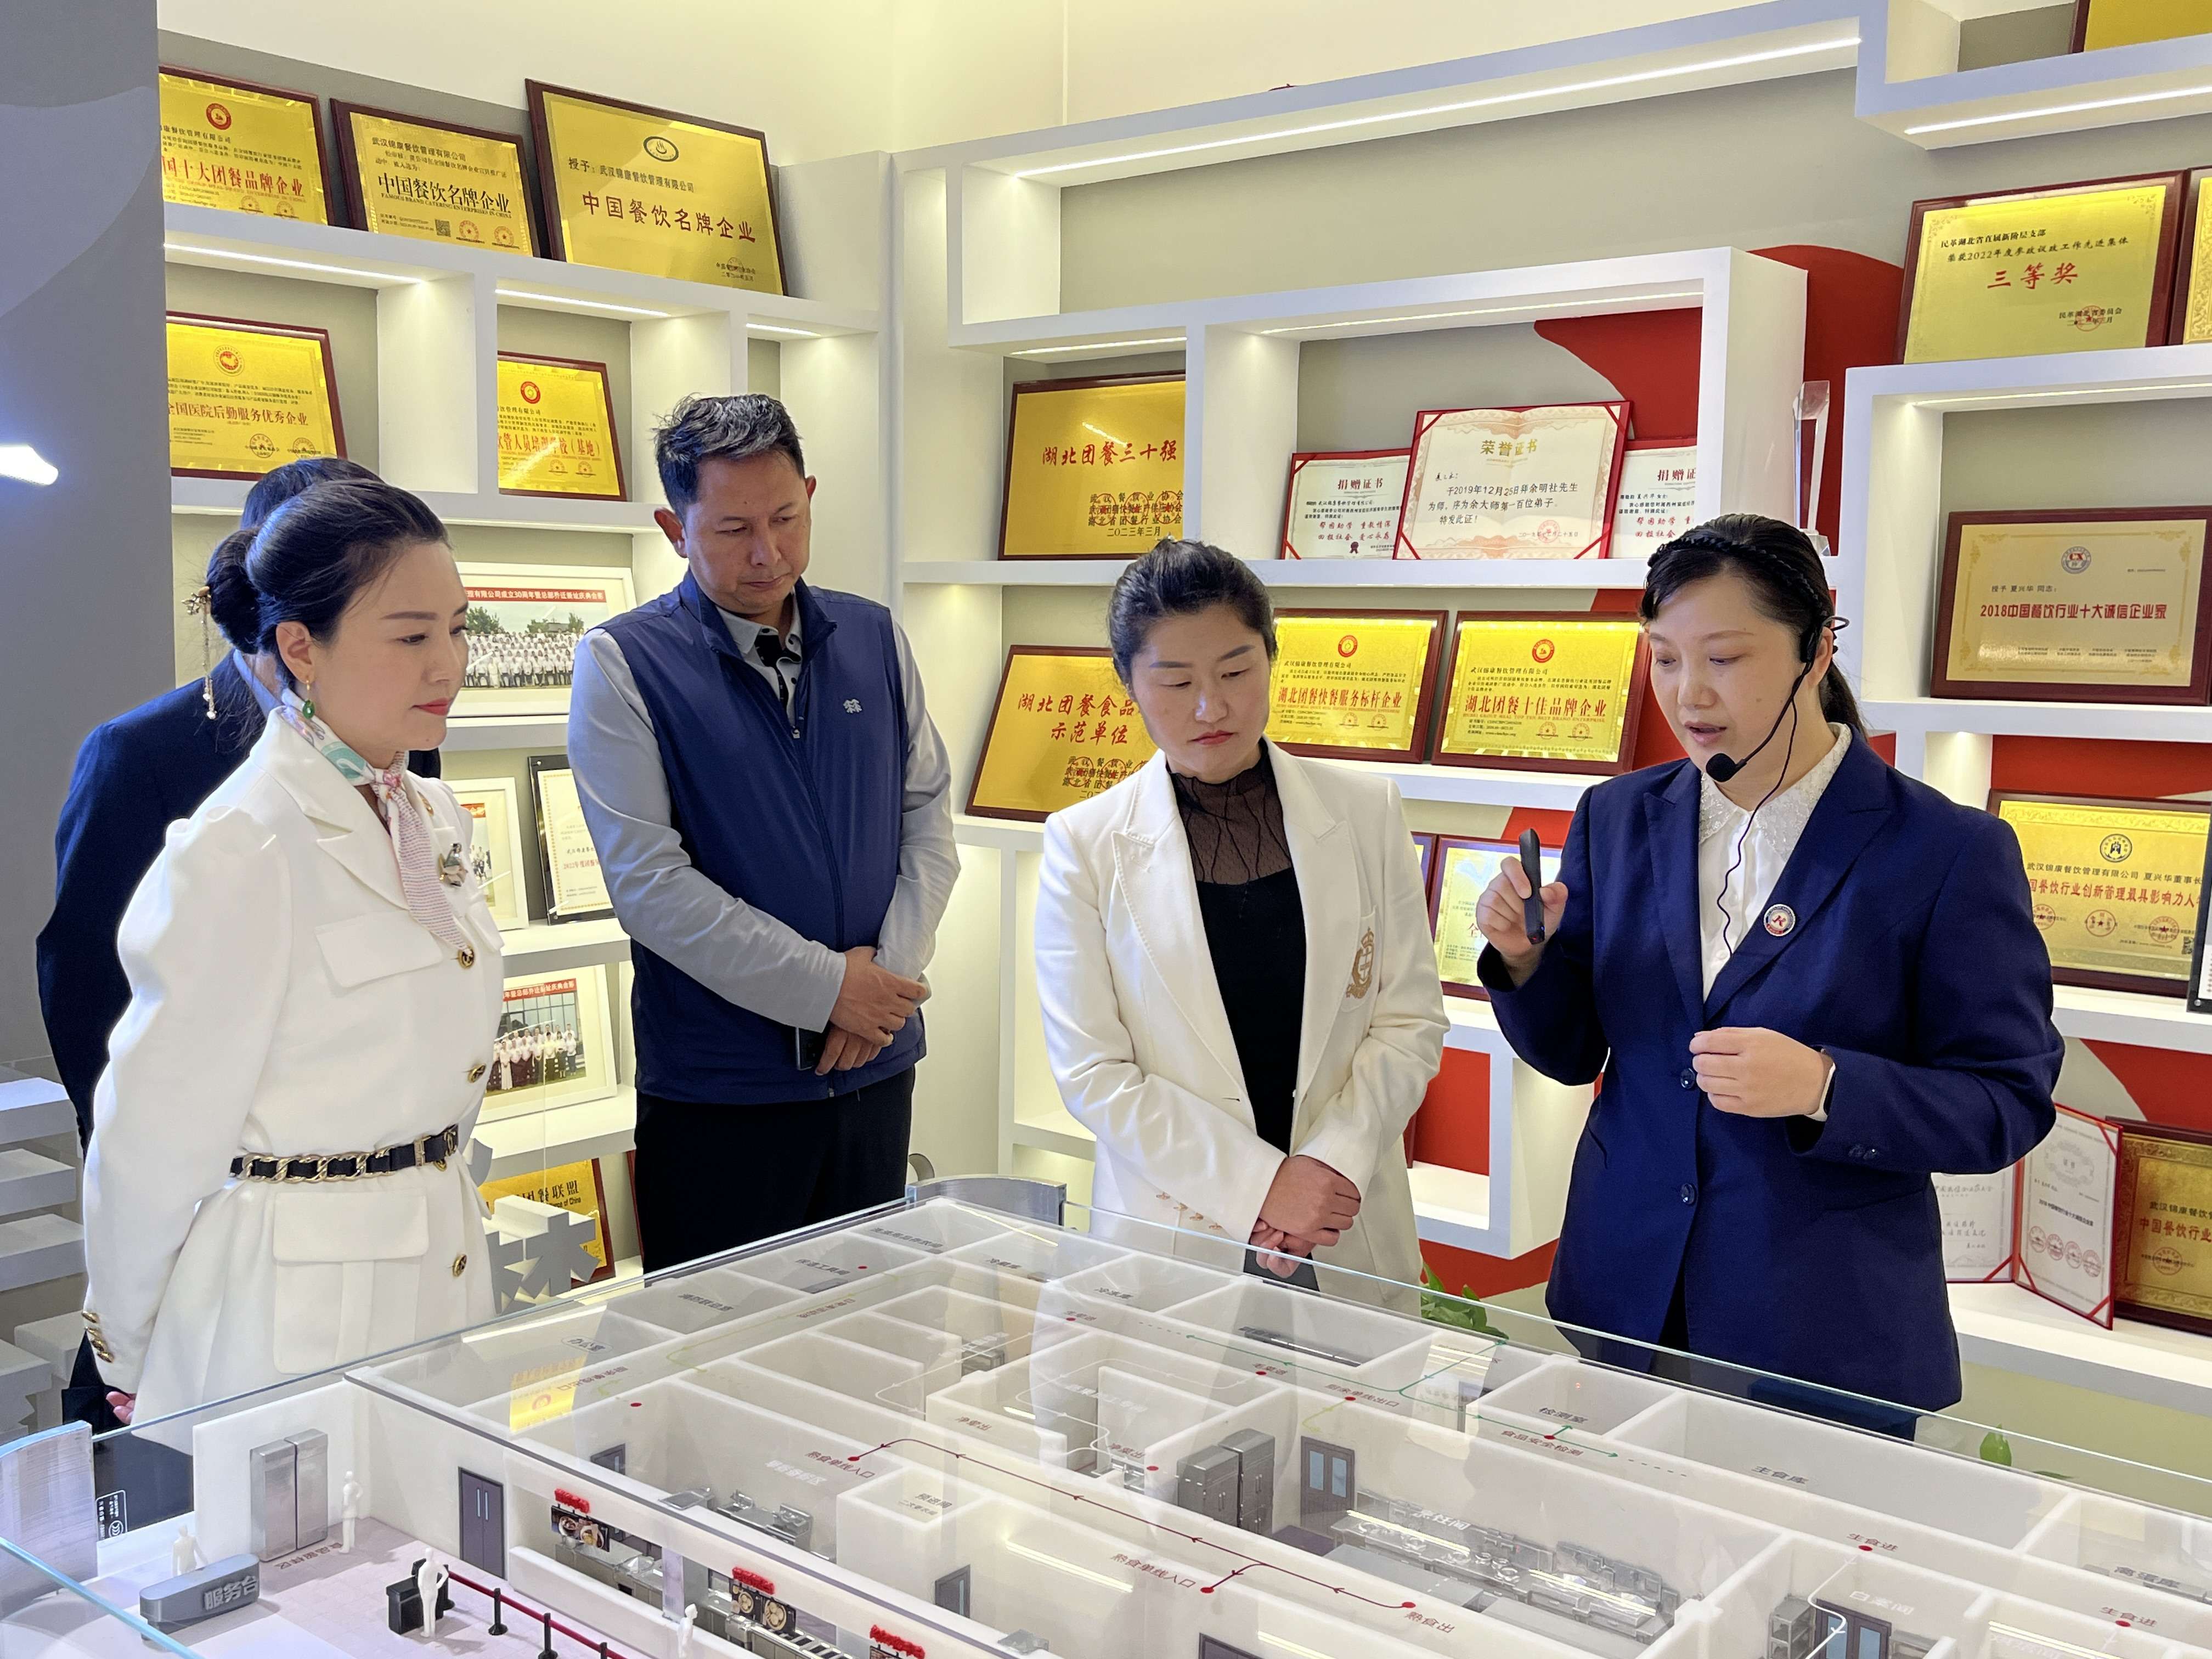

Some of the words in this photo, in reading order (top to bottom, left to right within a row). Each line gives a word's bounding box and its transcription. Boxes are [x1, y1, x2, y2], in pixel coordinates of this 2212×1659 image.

[161, 125, 231, 144] 康餐饮管理有限公司
[600, 165, 695, 193] 武汉锦康餐饮管理有限公司
[378, 173, 512, 213] 中国餐饮名牌企业
[582, 190, 756, 242] 中国餐饮名牌企业
[1947, 237, 2129, 263] 荣获2022年度参政议政工作先进集体
[1987, 262, 2078, 290] 三等奖
[1042, 439, 1177, 466] 湖北团餐三十强
[1481, 438, 1538, 456] 荣誉证书
[1338, 478, 1383, 490] 捐赠证书
[1980, 603, 2167, 620] 2018中国餐饮行业十大诚信企业家
[1018, 693, 1140, 716] 湖北团餐食品
[1278, 686, 1401, 708] 湖北团餐快餐服务标杆企业
[1465, 695, 1606, 717] 湖北团餐十佳品牌企业
[1051, 721, 1128, 745] 示范单位
[1062, 777, 1117, 789] 湖北省团餐
[2027, 863, 2139, 878] 武汉锦康餐饮管理有限公司
[2030, 879, 2202, 908] 国餐饮行业创新管理最具影响力人
[504, 981, 575, 998] 年暨总部乔迁新址庆典合影
[516, 1180, 579, 1203] 团餐联盟
[569, 1197, 581, 1205] China
[1539, 1407, 1588, 1424] 检测室
[1501, 1430, 1584, 1457] 食品安全检测
[1751, 1465, 1809, 1485] 主食库
[1846, 1533, 1899, 1552] 生食进
[1110, 1553, 1197, 1588] 熟食单线入口
[204, 1575, 259, 1611] 服务台
[1404, 1611, 1455, 1634] 熟食出
[2100, 1606, 2158, 1628] 生食进
